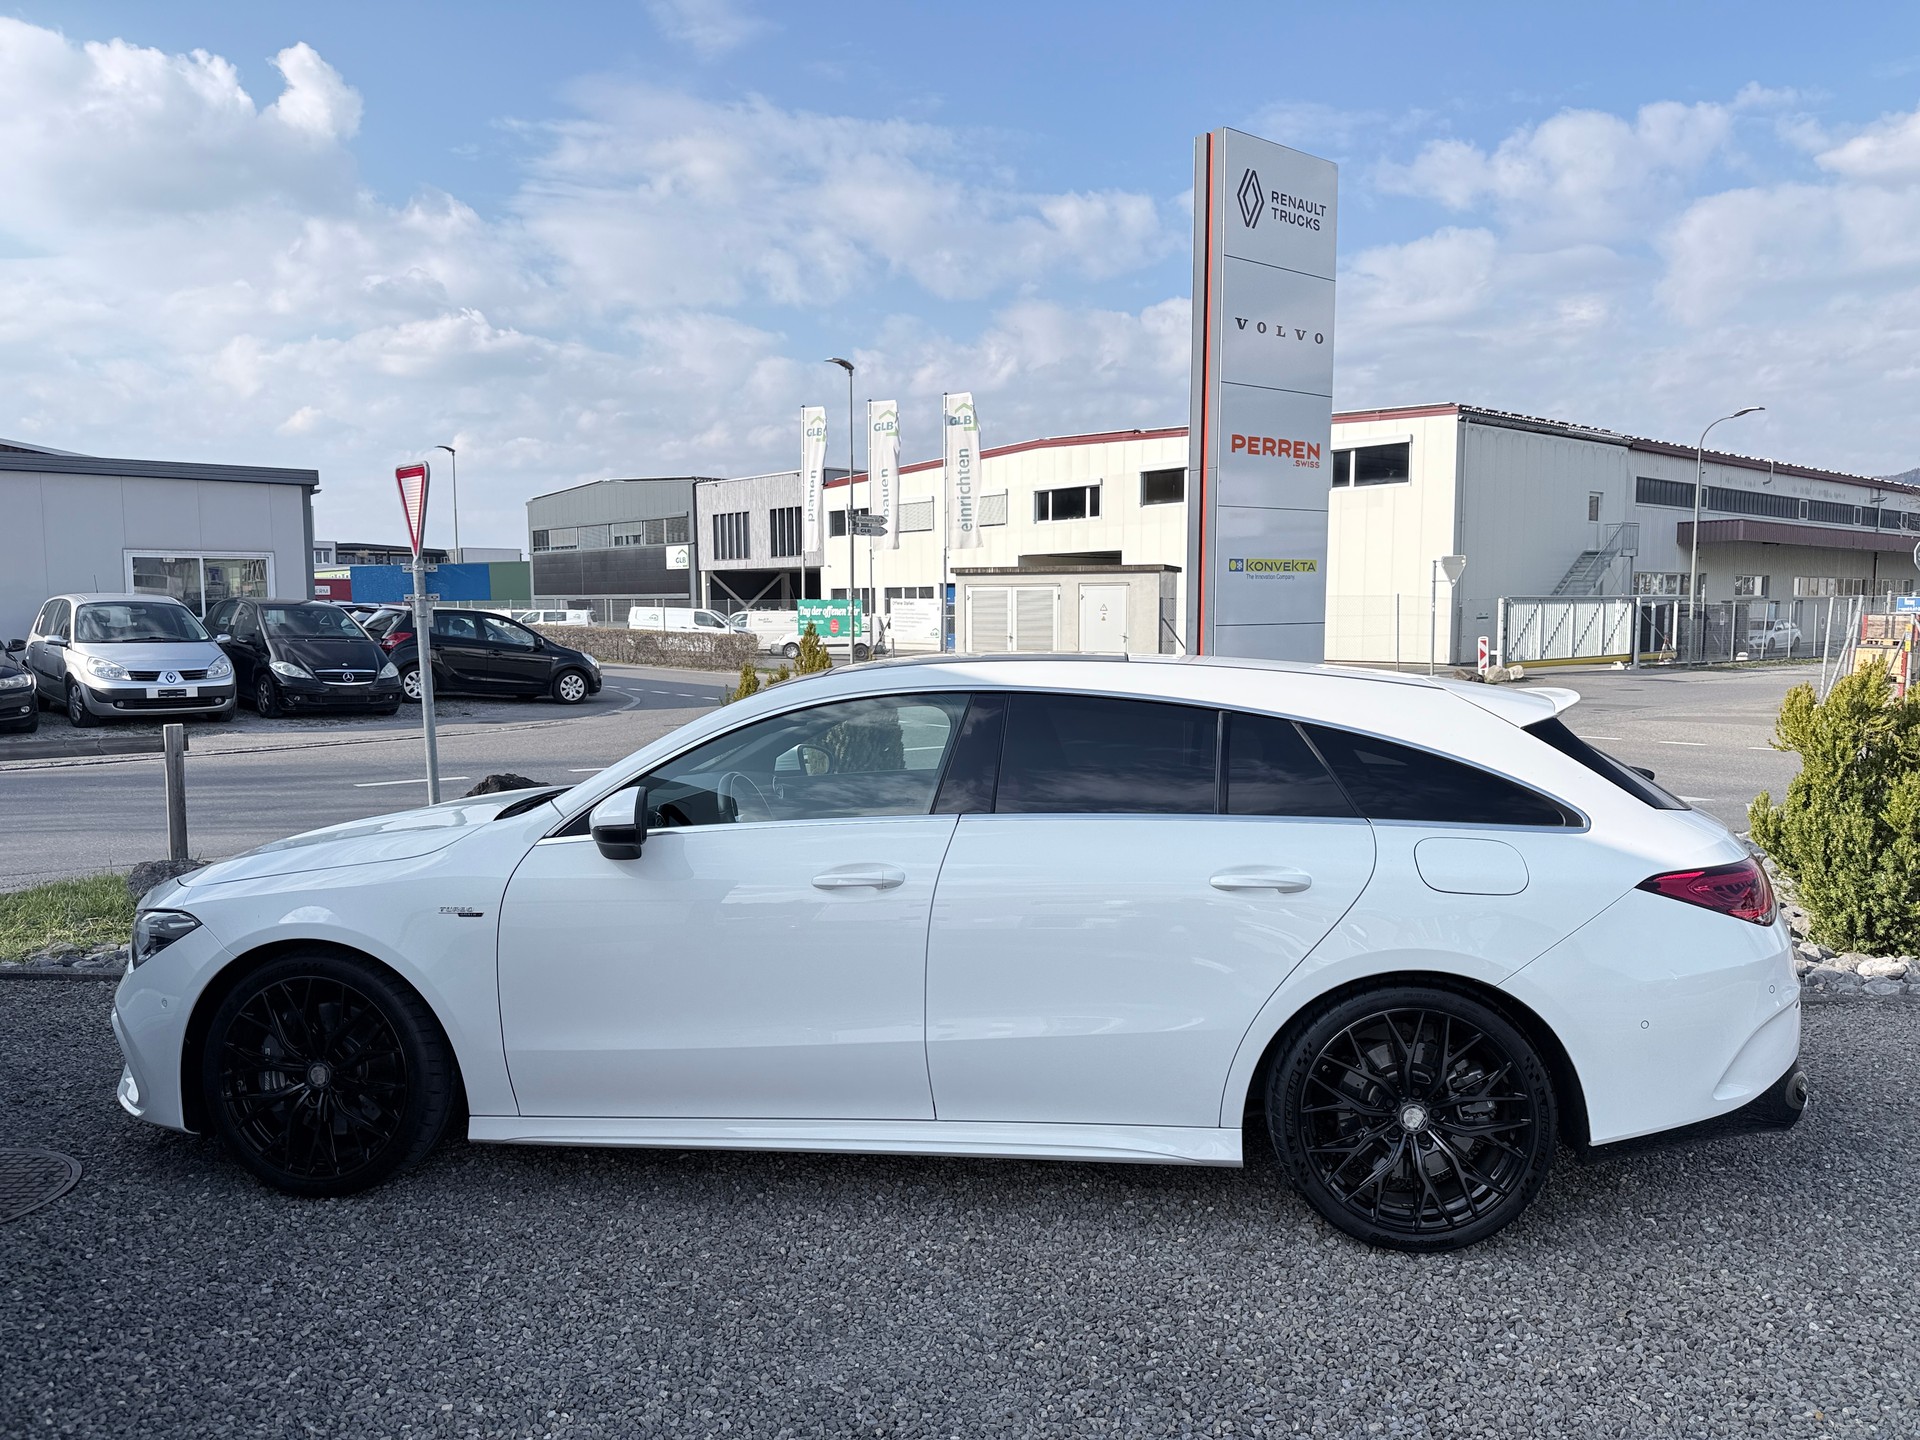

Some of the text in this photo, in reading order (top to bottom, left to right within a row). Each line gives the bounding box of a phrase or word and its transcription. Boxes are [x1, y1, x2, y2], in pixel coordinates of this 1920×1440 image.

[1271, 190, 1327, 217] RENAULT
[1271, 207, 1321, 231] TRUCKS
[1234, 317, 1324, 344] VOLVO
[873, 421, 894, 432] GLB
[949, 415, 972, 425] GLB
[806, 427, 823, 438] GLB
[1231, 434, 1320, 460] PERREN
[1292, 459, 1320, 469] .SWISS
[807, 469, 817, 523] planen
[880, 468, 890, 518] bauen
[956, 448, 973, 533] einrichten
[1246, 558, 1316, 572] KONVEKTA
[799, 605, 811, 618] Tag
[811, 605, 822, 616] der
[822, 604, 847, 619] offenen
